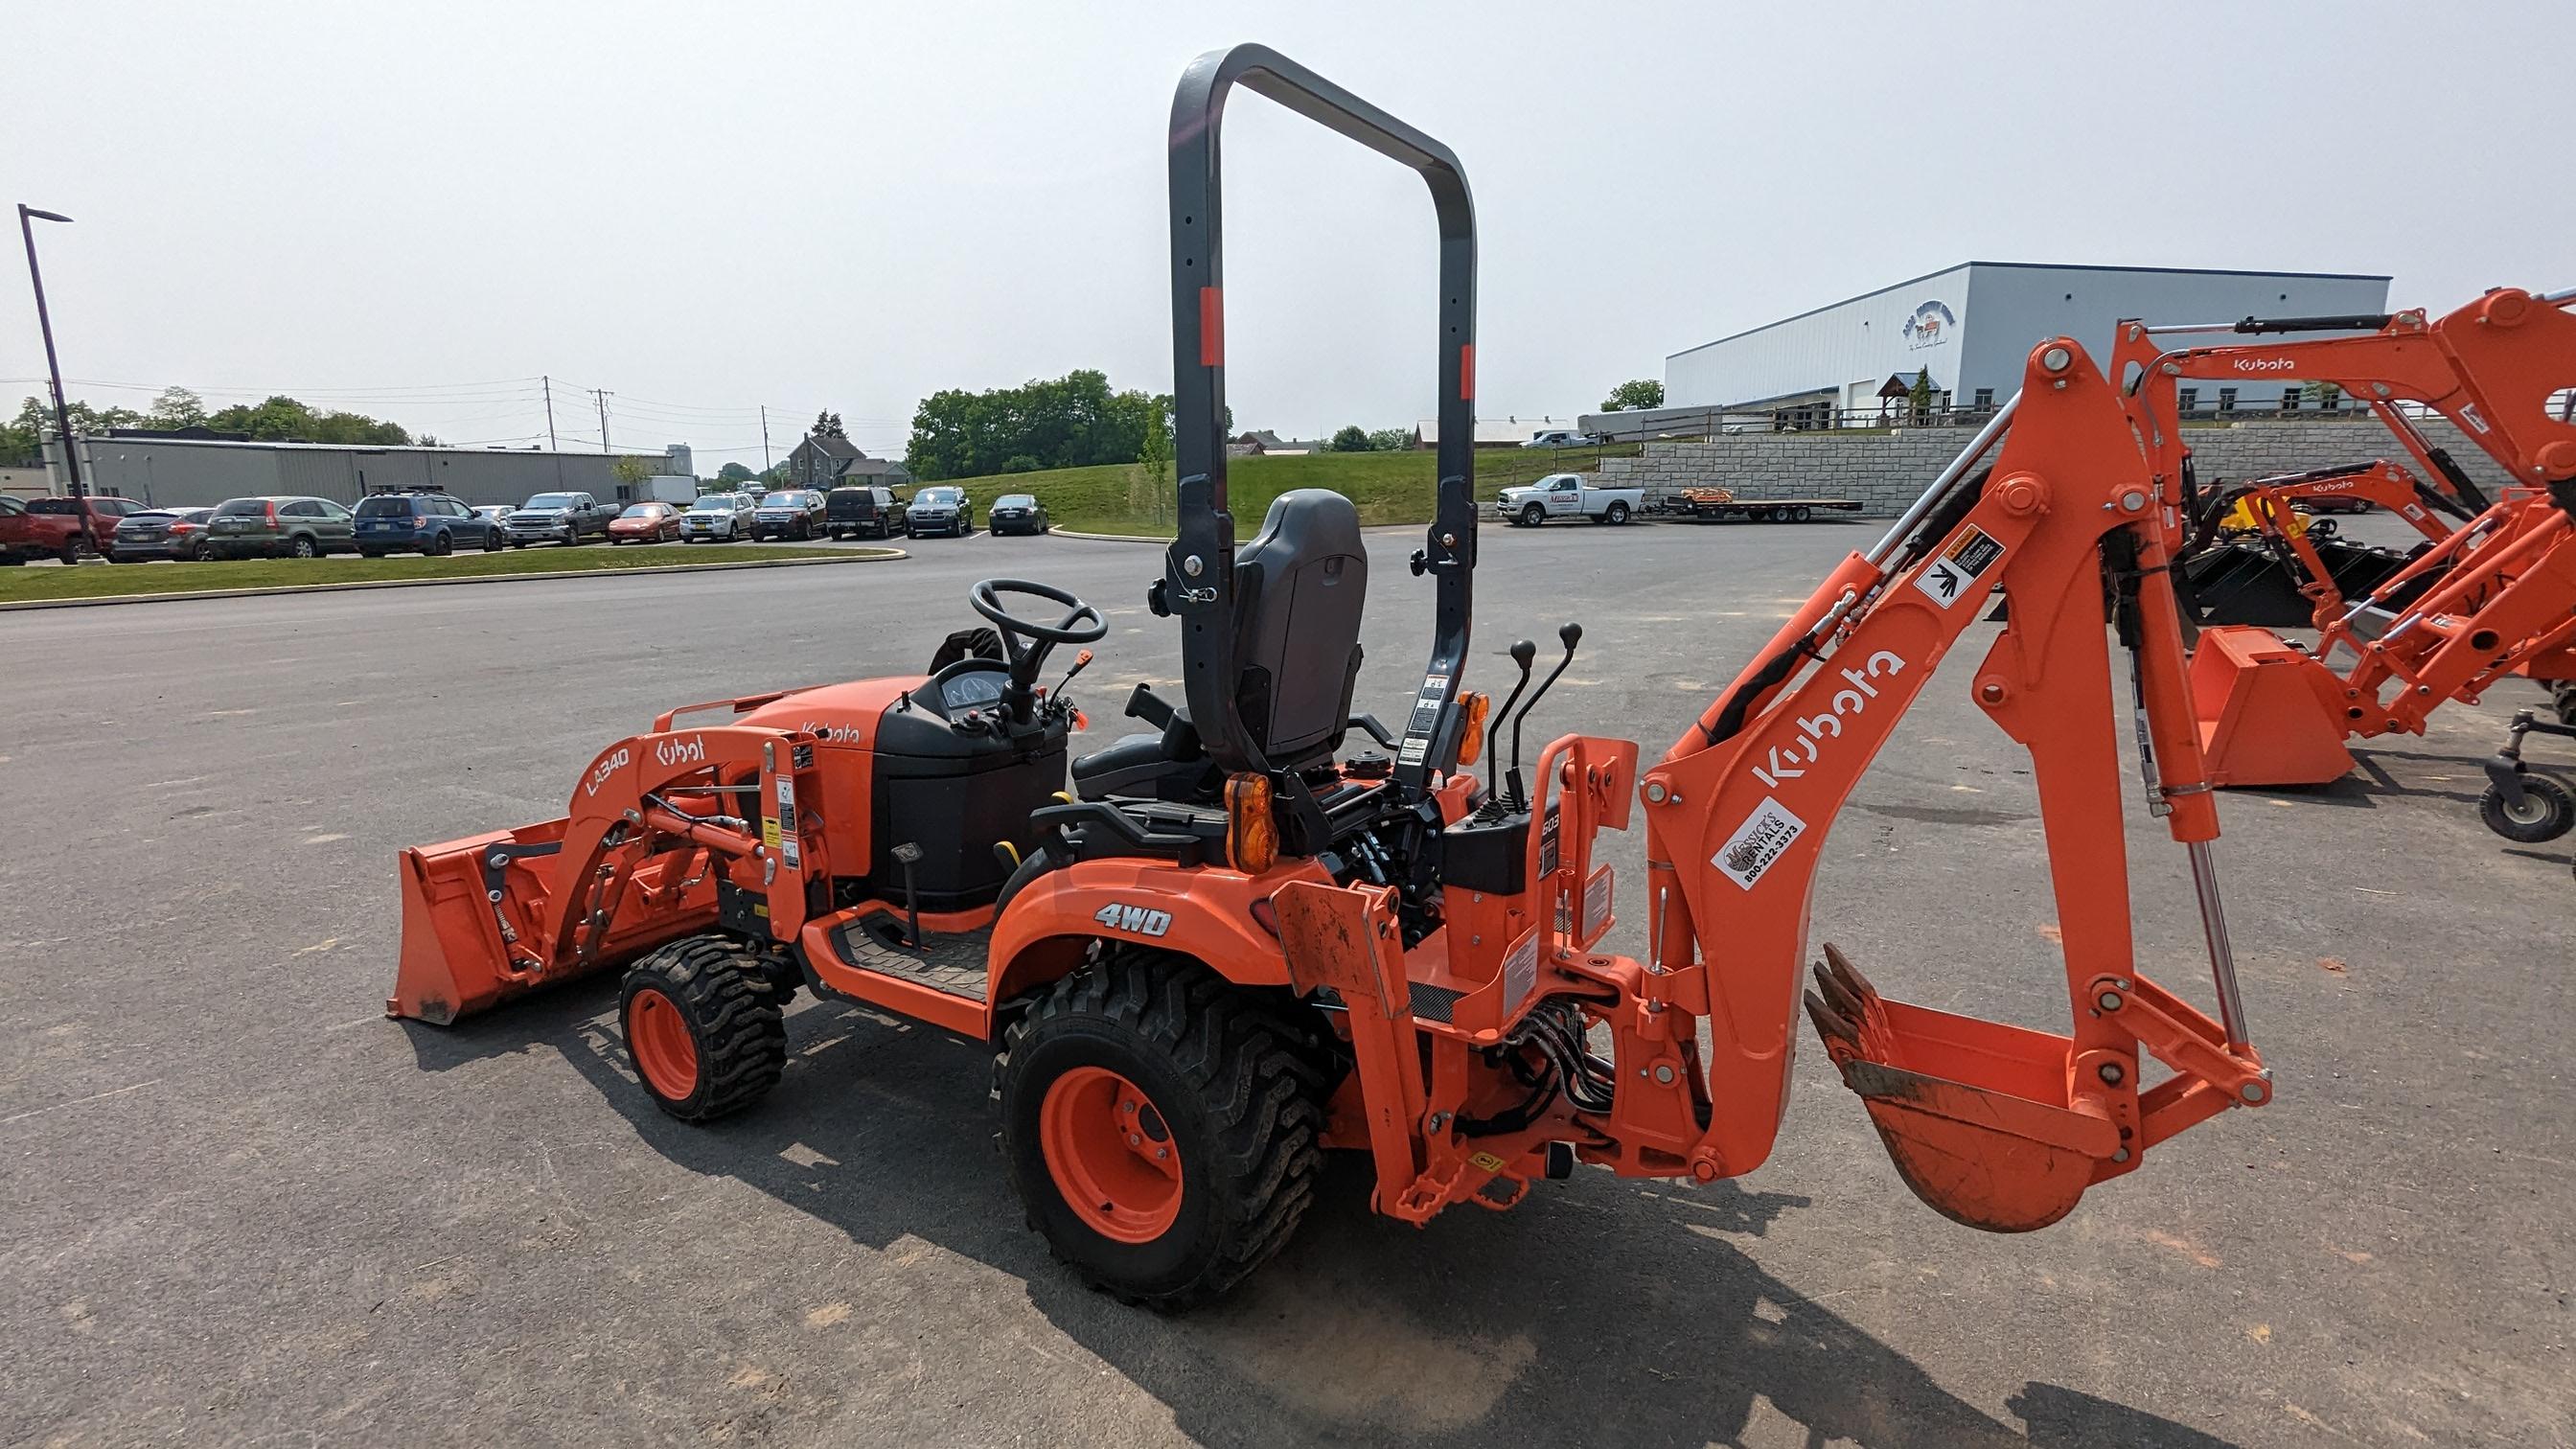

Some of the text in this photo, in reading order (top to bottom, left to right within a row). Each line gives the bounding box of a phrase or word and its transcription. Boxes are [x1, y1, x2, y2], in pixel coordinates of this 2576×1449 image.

[2234, 357, 2294, 371] Kubota
[2312, 480, 2354, 493] Kubota
[1752, 651, 1906, 789] Kubota
[586, 748, 630, 796] LA340
[1742, 819, 1784, 864] RENTALS
[1744, 825, 1798, 883] 800-222-3373
[1094, 903, 1172, 936] 4WD
